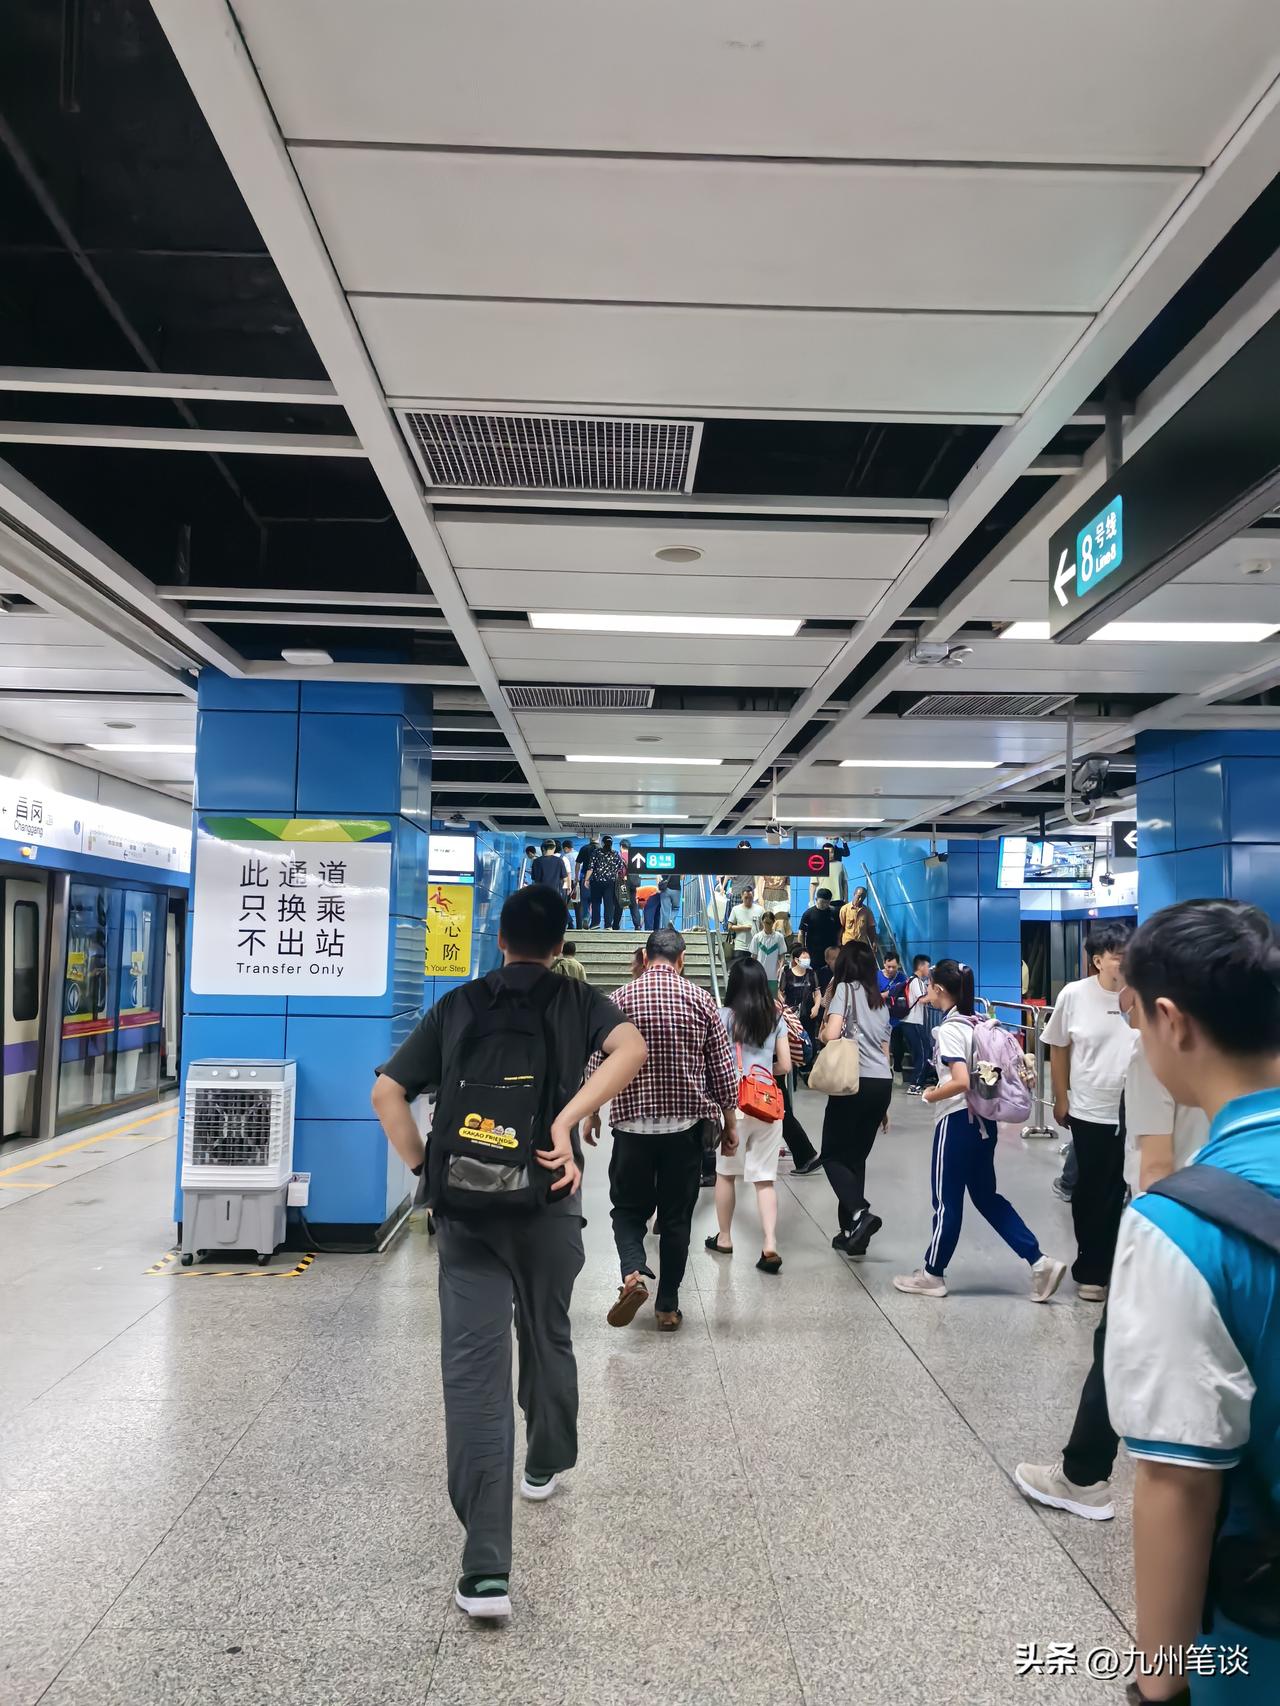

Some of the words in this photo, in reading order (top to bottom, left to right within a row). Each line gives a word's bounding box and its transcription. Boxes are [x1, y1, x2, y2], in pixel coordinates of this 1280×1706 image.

[14, 819, 44, 838] Changgang
[239, 859, 347, 888] 此通道
[238, 893, 345, 923] 只换乘
[237, 928, 345, 957] 不出站
[236, 962, 302, 974] Transfer
[309, 963, 344, 977] Only
[431, 964, 447, 972] Your
[449, 964, 466, 973] Step
[462, 1129, 484, 1139] KAKAO
